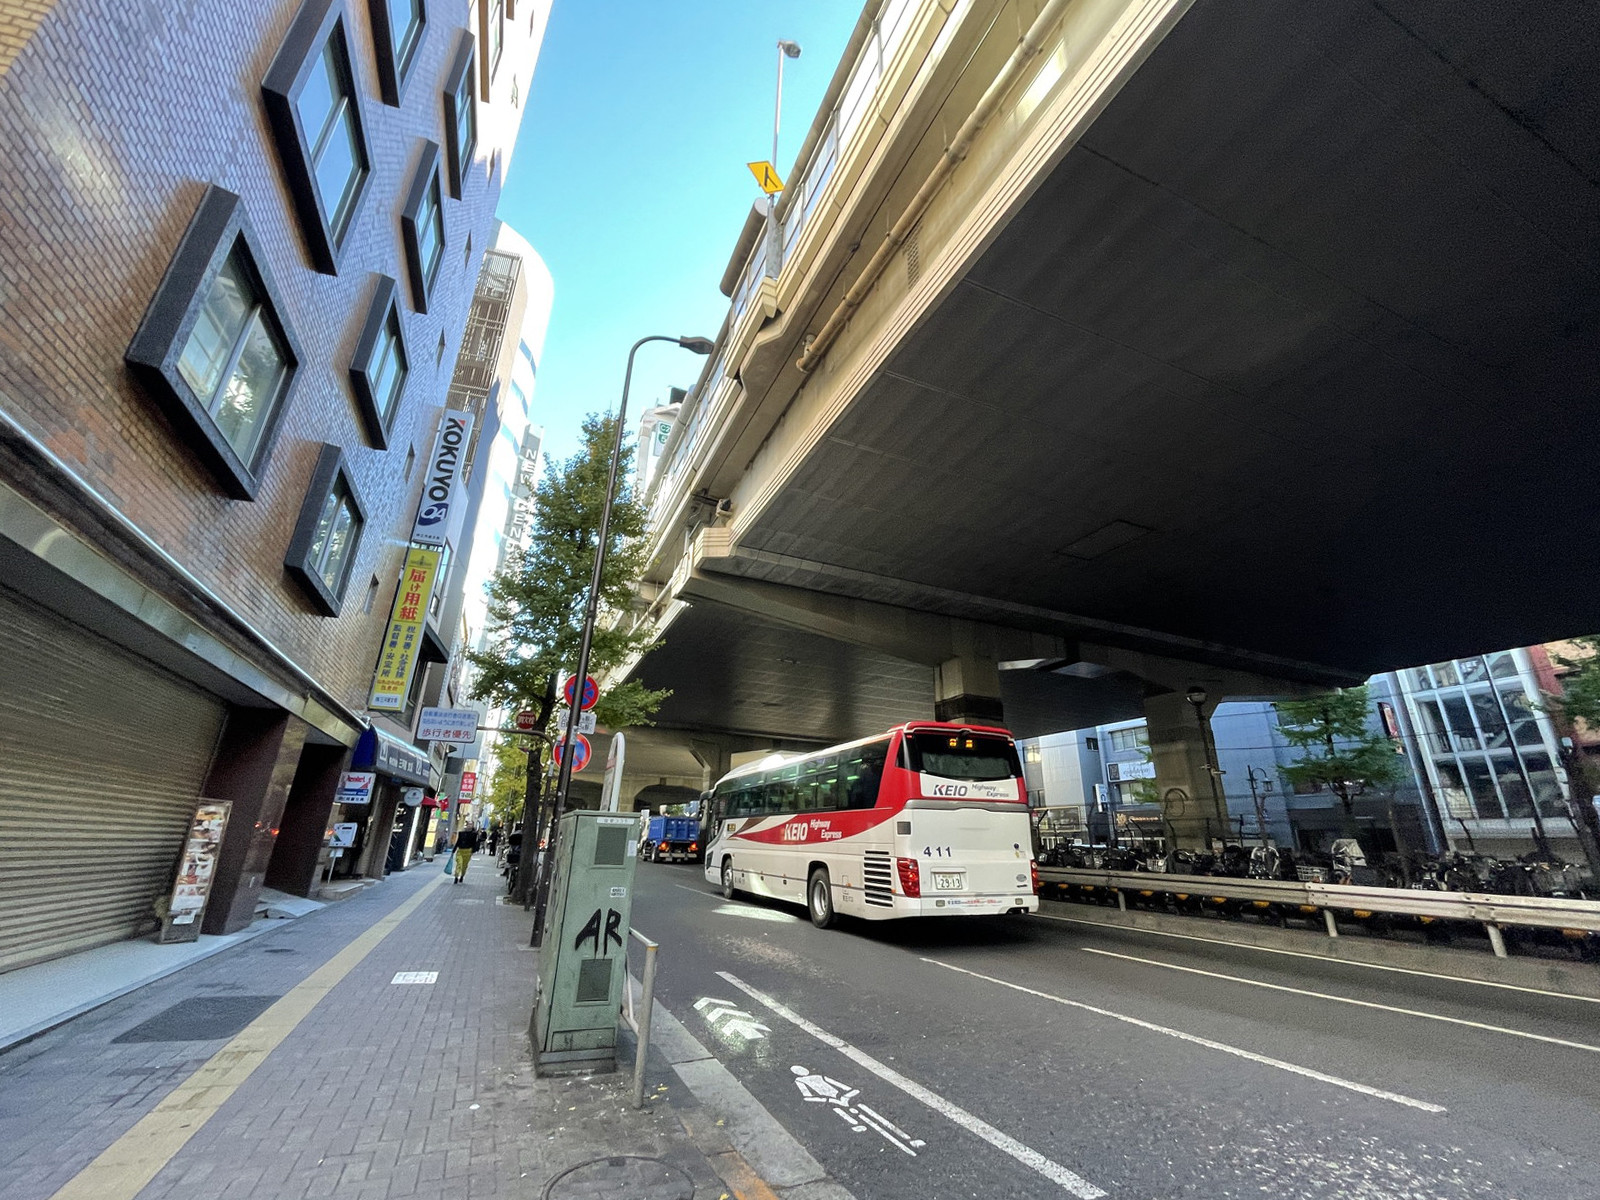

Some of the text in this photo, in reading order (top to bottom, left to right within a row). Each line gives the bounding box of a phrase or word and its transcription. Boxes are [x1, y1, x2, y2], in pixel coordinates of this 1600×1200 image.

[428, 417, 465, 502] KOKUYO
[400, 568, 427, 620] 届け用紙
[422, 728, 472, 739] 歩行者優先
[933, 783, 997, 797] KEIO Highway
[986, 790, 1010, 798] Express
[784, 819, 831, 841] KEIO Highway
[821, 829, 842, 840] Express
